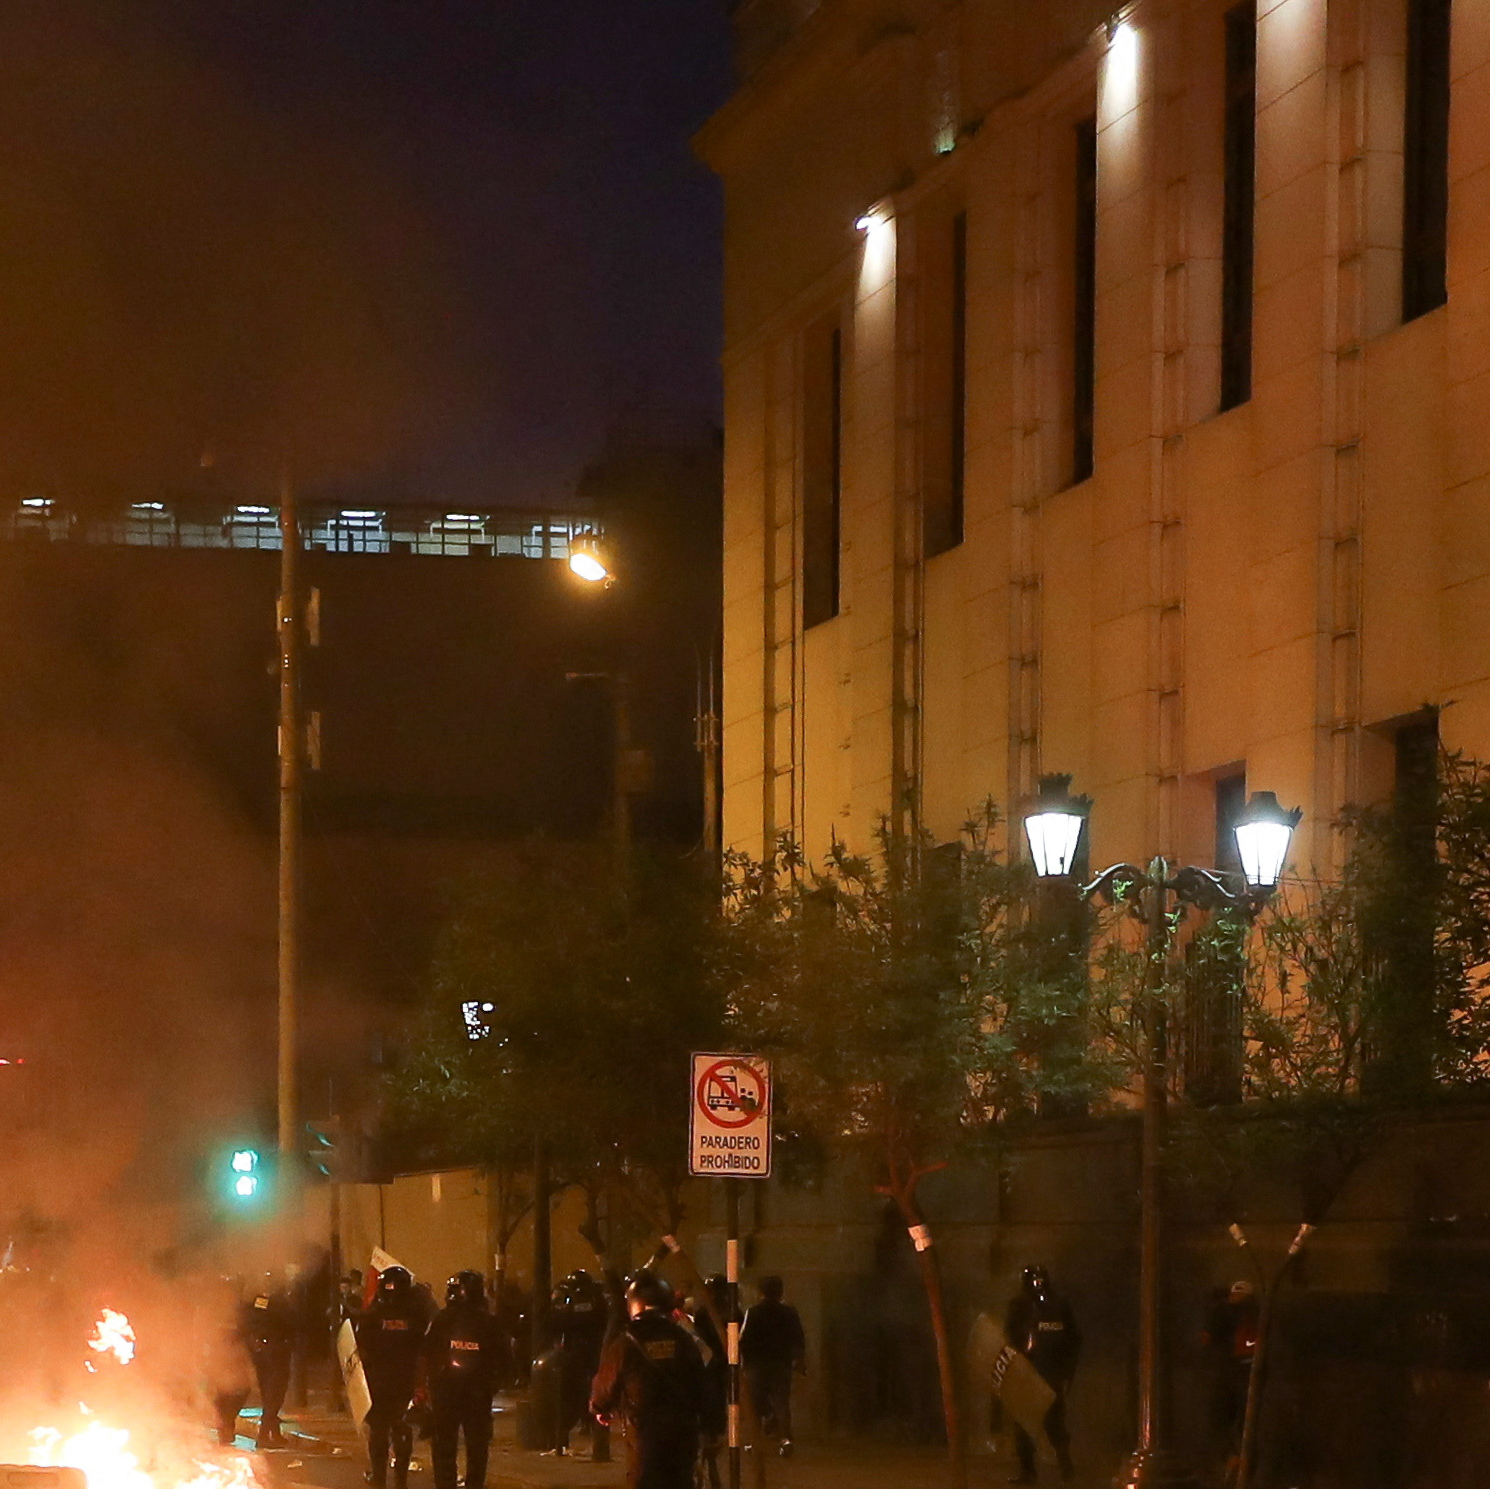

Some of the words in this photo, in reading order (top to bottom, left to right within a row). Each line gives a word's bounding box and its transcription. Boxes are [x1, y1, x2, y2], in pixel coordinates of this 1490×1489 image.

[700, 1135, 760, 1150] PARADERO
[699, 1154, 761, 1170] PROHIBIDO
[450, 1340, 480, 1351] POLICIA
